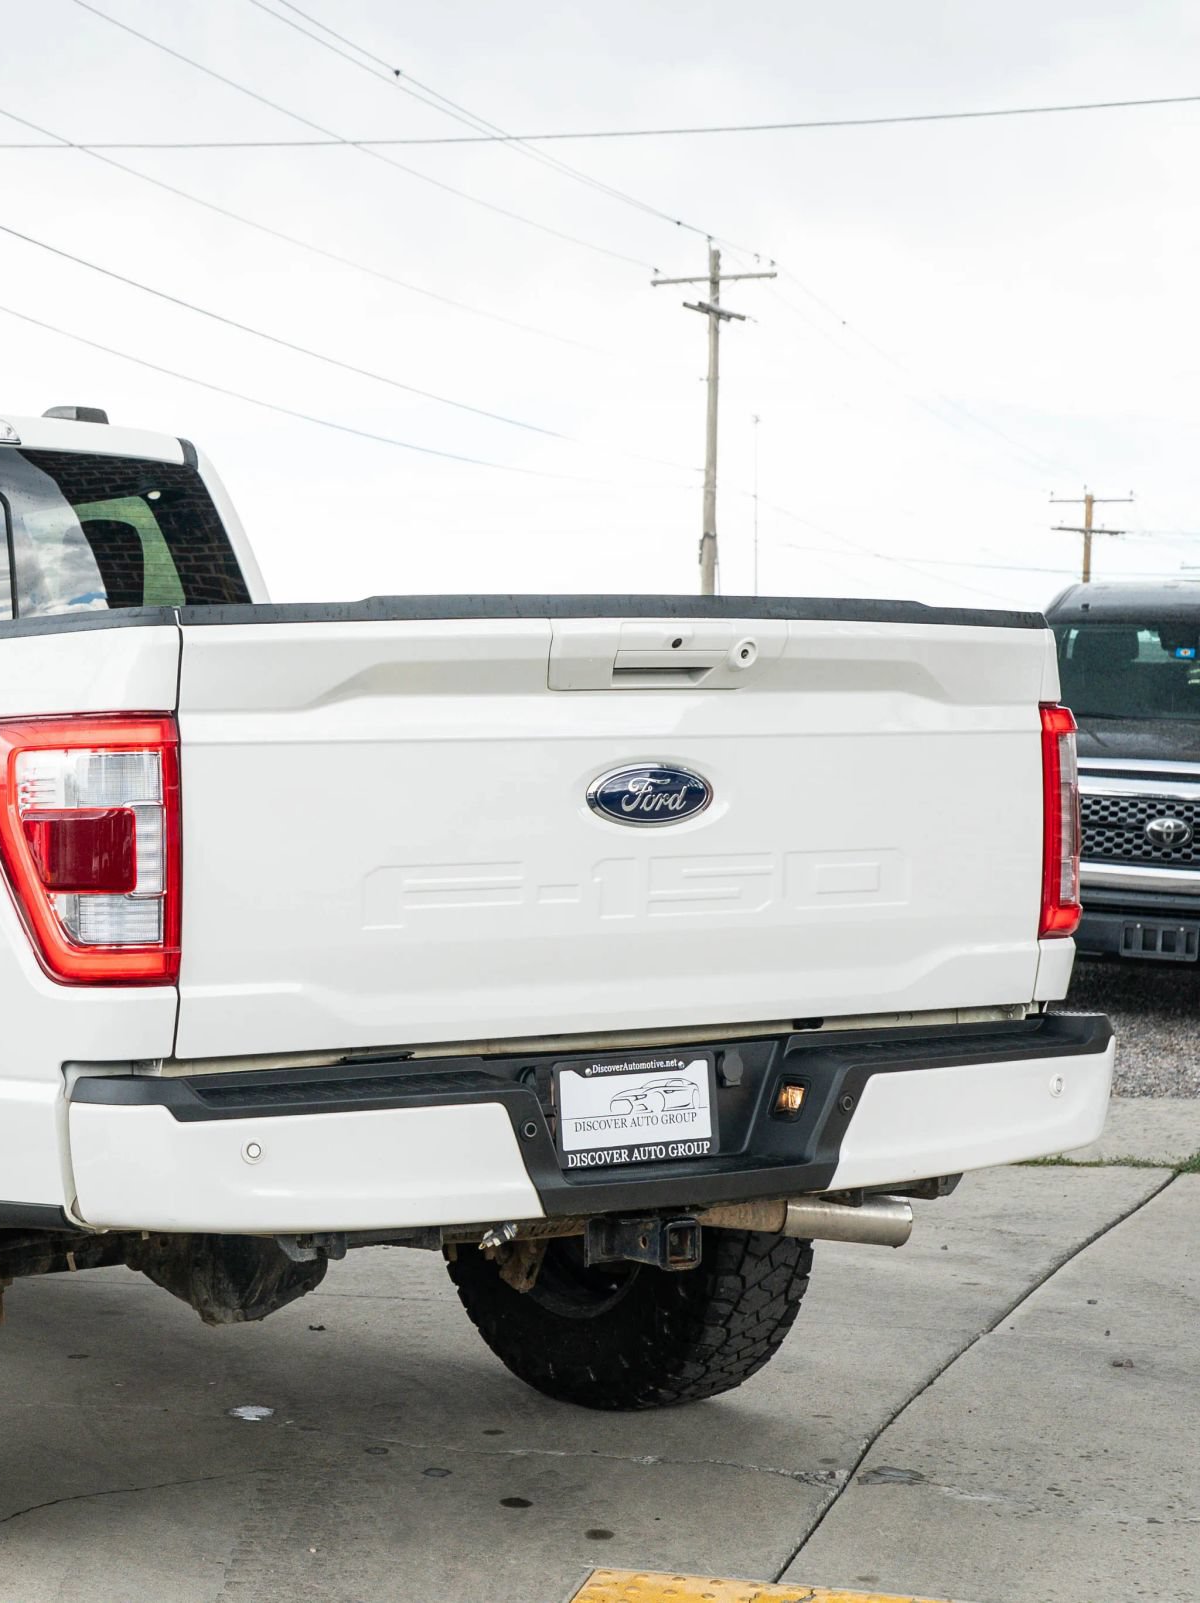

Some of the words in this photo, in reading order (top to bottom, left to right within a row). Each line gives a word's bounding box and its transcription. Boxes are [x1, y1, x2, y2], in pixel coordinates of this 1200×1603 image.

[621, 777, 687, 812] Ford
[361, 847, 911, 930] F-150
[592, 1058, 678, 1074] DiscoverAutomotive.net
[574, 1119, 627, 1133] DISCOVER
[630, 1116, 659, 1128] AUTO
[661, 1112, 697, 1125] GROUP
[567, 1148, 630, 1168] DISCOVER
[632, 1145, 666, 1161] AUTO
[668, 1141, 710, 1158] GROUP
